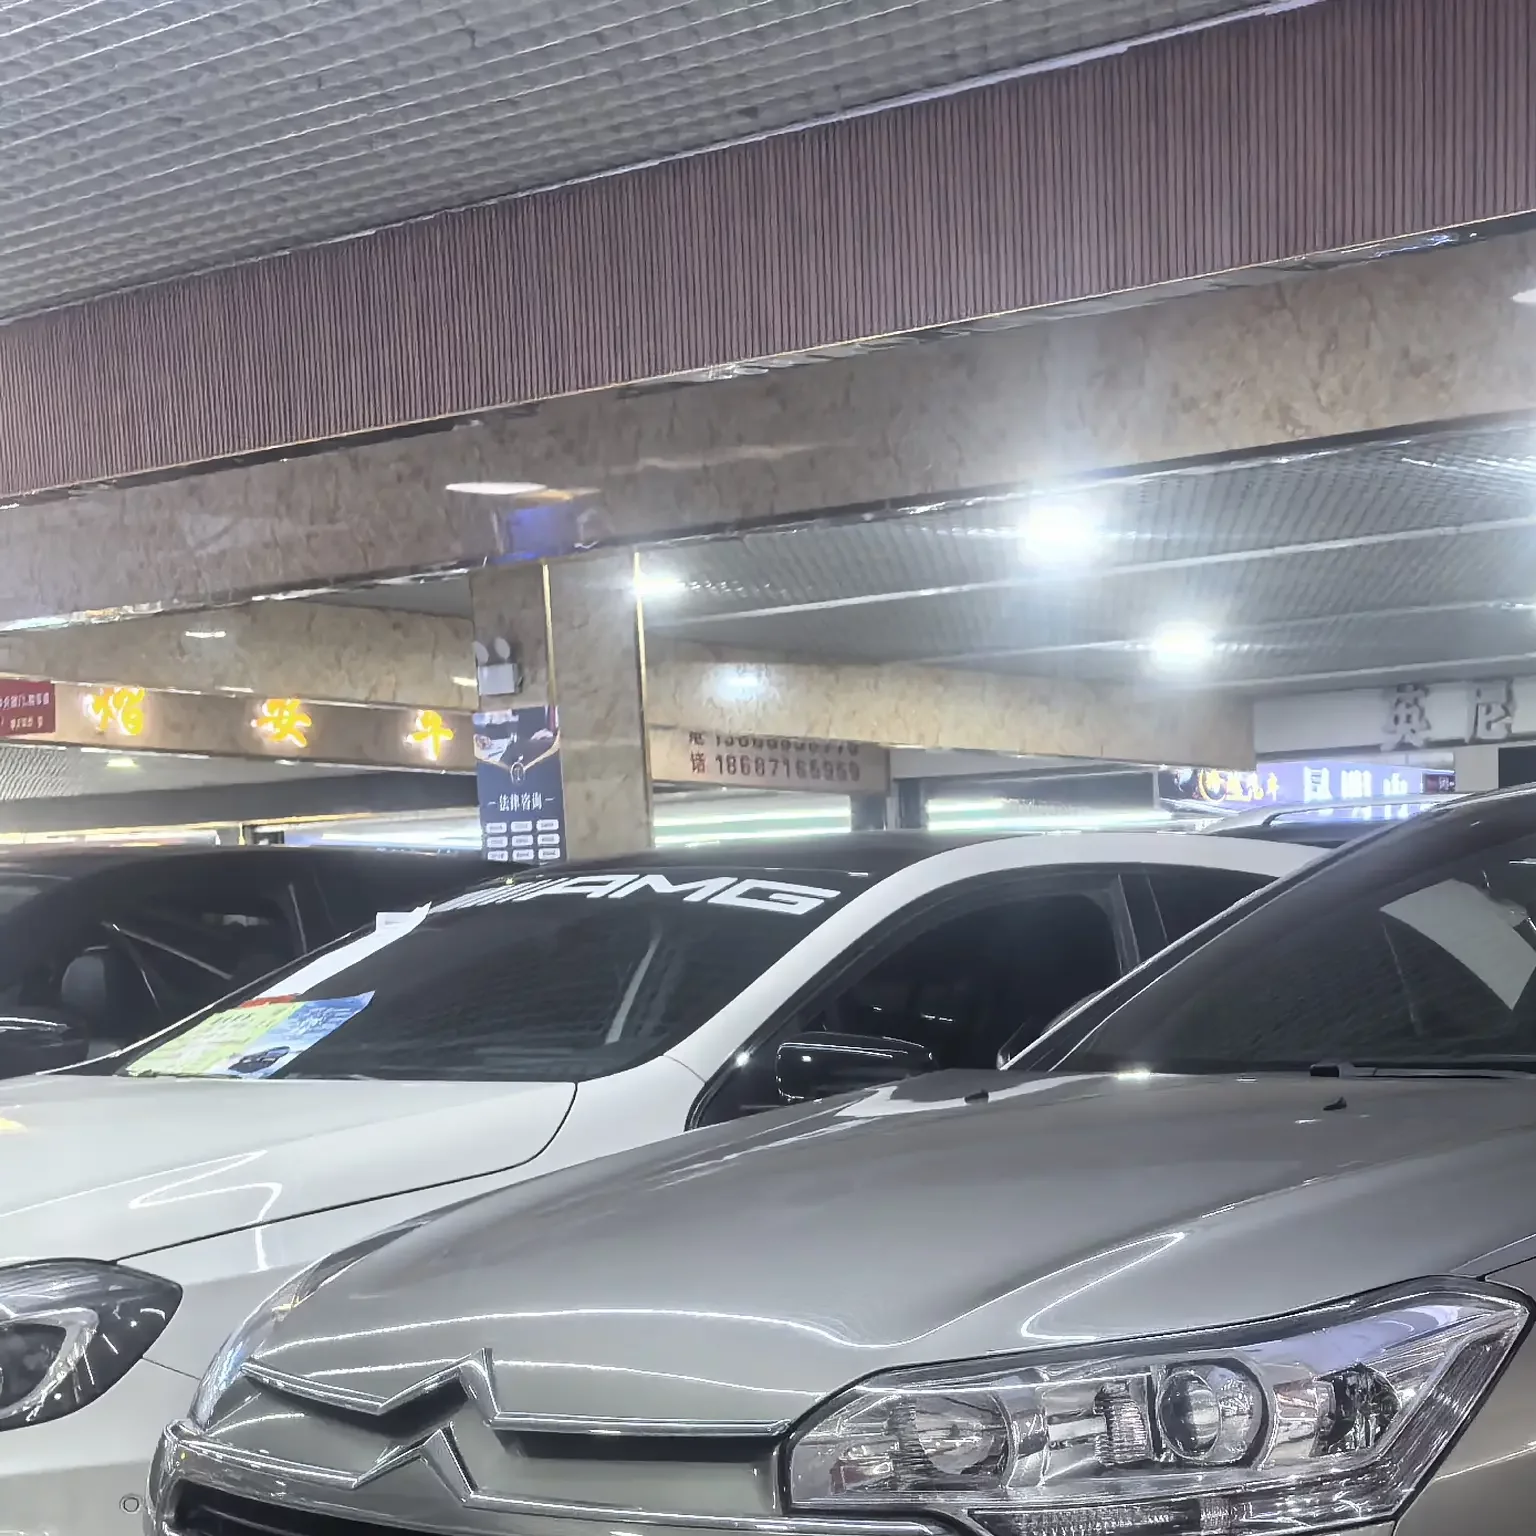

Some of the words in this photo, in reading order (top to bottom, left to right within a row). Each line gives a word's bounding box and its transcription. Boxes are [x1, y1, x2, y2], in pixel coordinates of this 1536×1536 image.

[499, 791, 543, 813] 法律咨询
[514, 873, 842, 916] AMG
